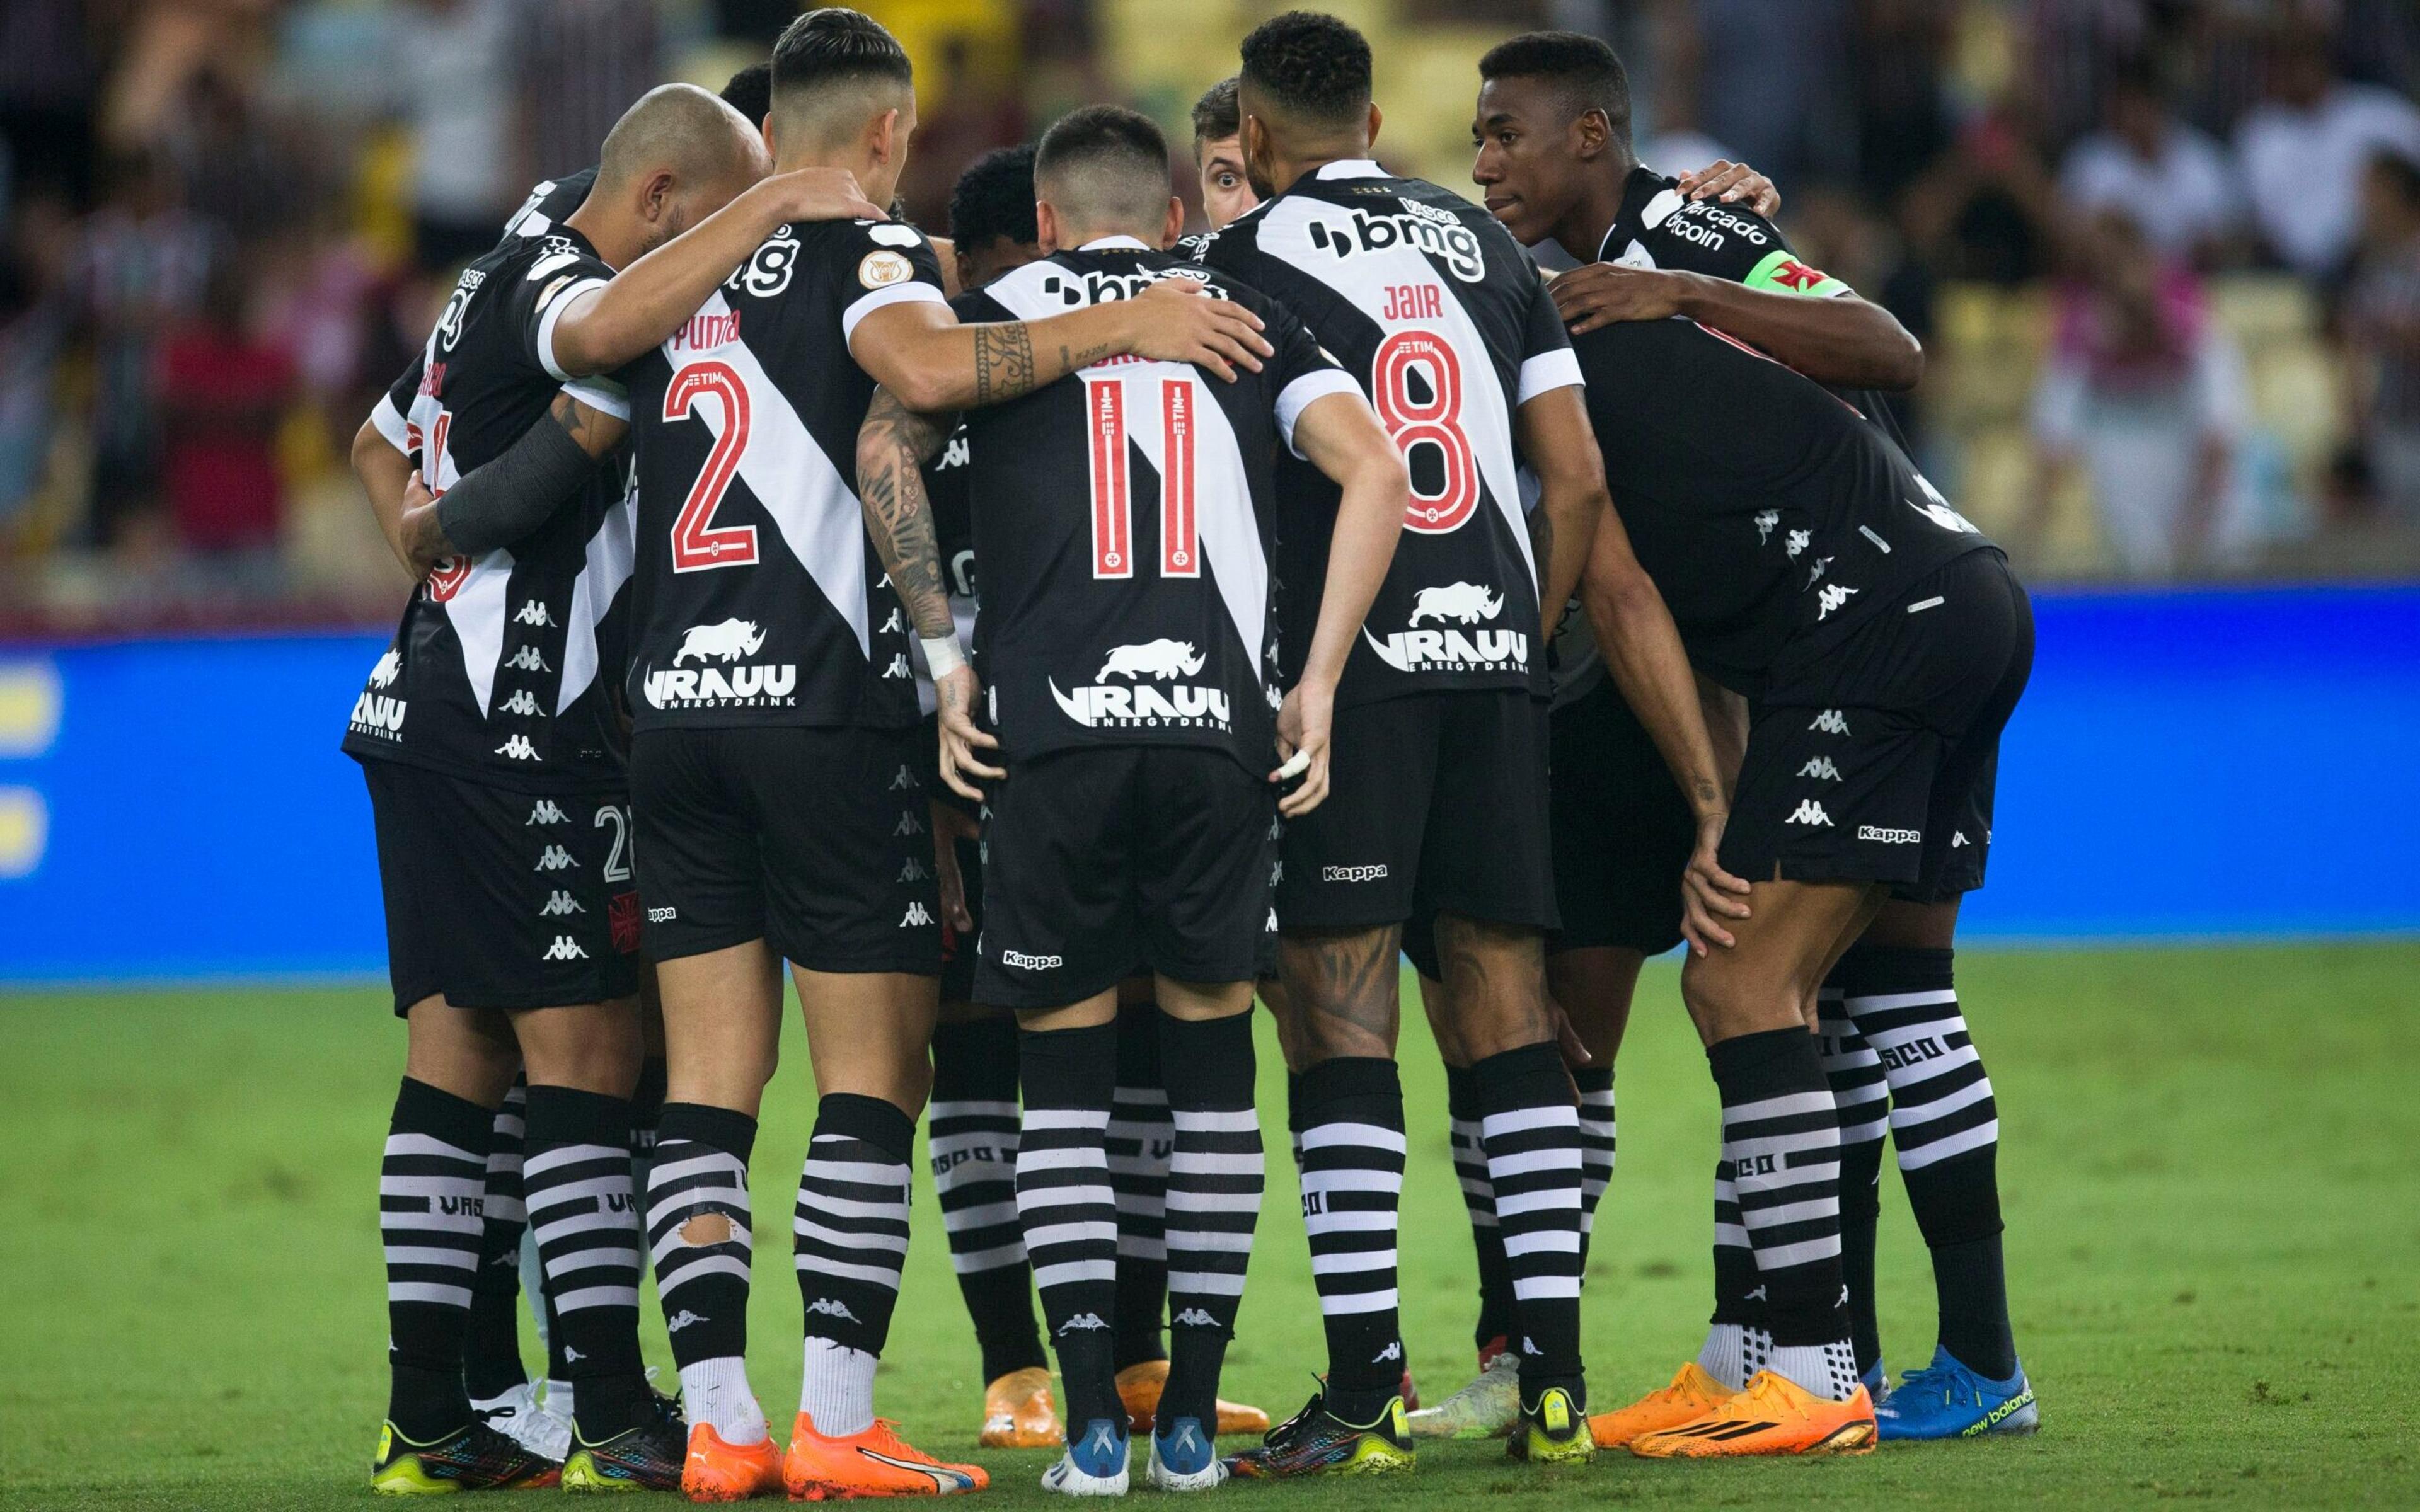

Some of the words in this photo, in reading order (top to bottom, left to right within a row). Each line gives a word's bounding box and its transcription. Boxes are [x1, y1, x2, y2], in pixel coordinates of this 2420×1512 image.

[1398, 197, 1461, 224] VASCO
[1352, 210, 1489, 281] bmg
[1412, 341, 1434, 353] TIM
[701, 371, 722, 384] TIM
[1100, 397, 1114, 421] TIM
[1172, 397, 1185, 421] TIM
[1373, 329, 1480, 535] 8
[663, 360, 759, 574] 2
[1085, 377, 1201, 579] 11
[1409, 661, 1477, 672] ENERGY
[660, 698, 727, 709] ENERGY
[734, 697, 796, 707] DRINK
[1091, 717, 1172, 728] ENERGY
[1858, 825, 1920, 843] Kappa
[1323, 864, 1388, 882] Kappa
[1003, 950, 1062, 970] Kappa
[1988, 1390, 2034, 1424] balance
